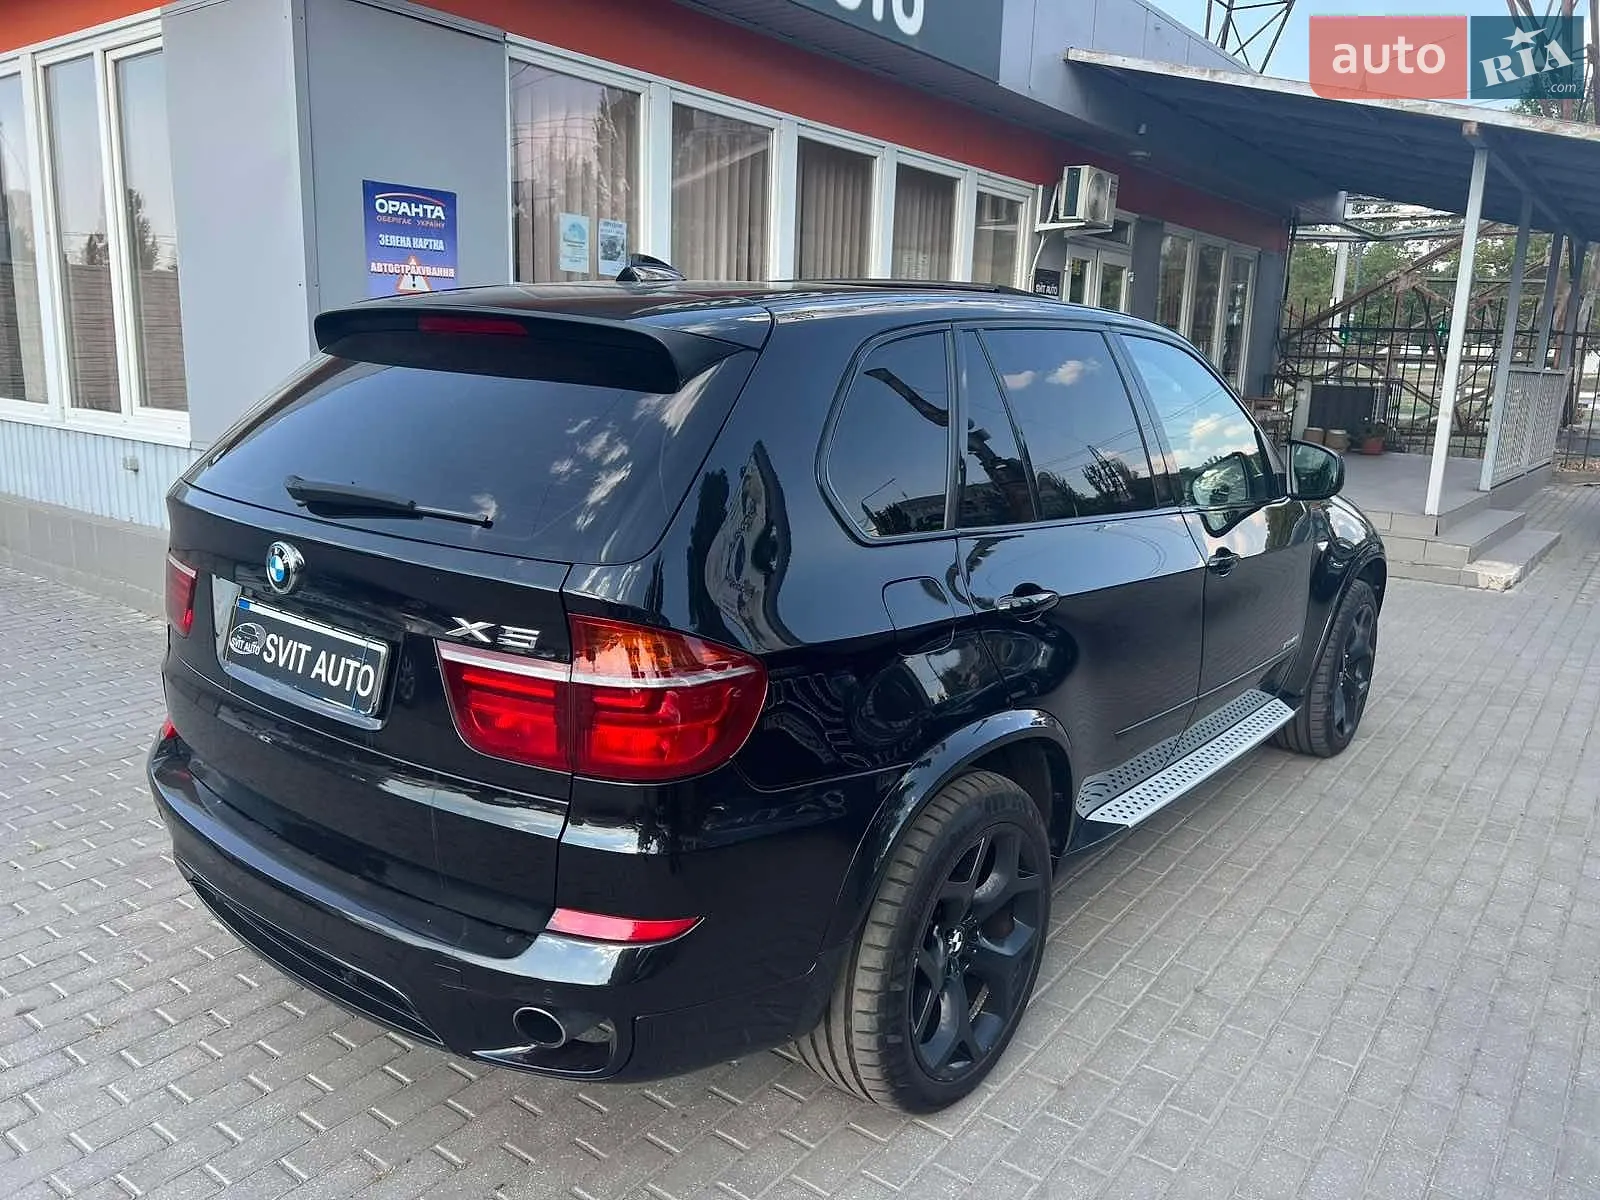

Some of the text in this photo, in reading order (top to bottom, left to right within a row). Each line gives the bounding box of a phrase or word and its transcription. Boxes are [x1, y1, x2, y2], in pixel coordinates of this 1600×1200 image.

[375, 198, 446, 220] ОРАНТА
[379, 234, 444, 250] ЗЕЛЕНА КАРТКА
[370, 262, 455, 278] АВТОСТРАХУВАННЯ
[263, 633, 375, 697] SVIT AUTO
